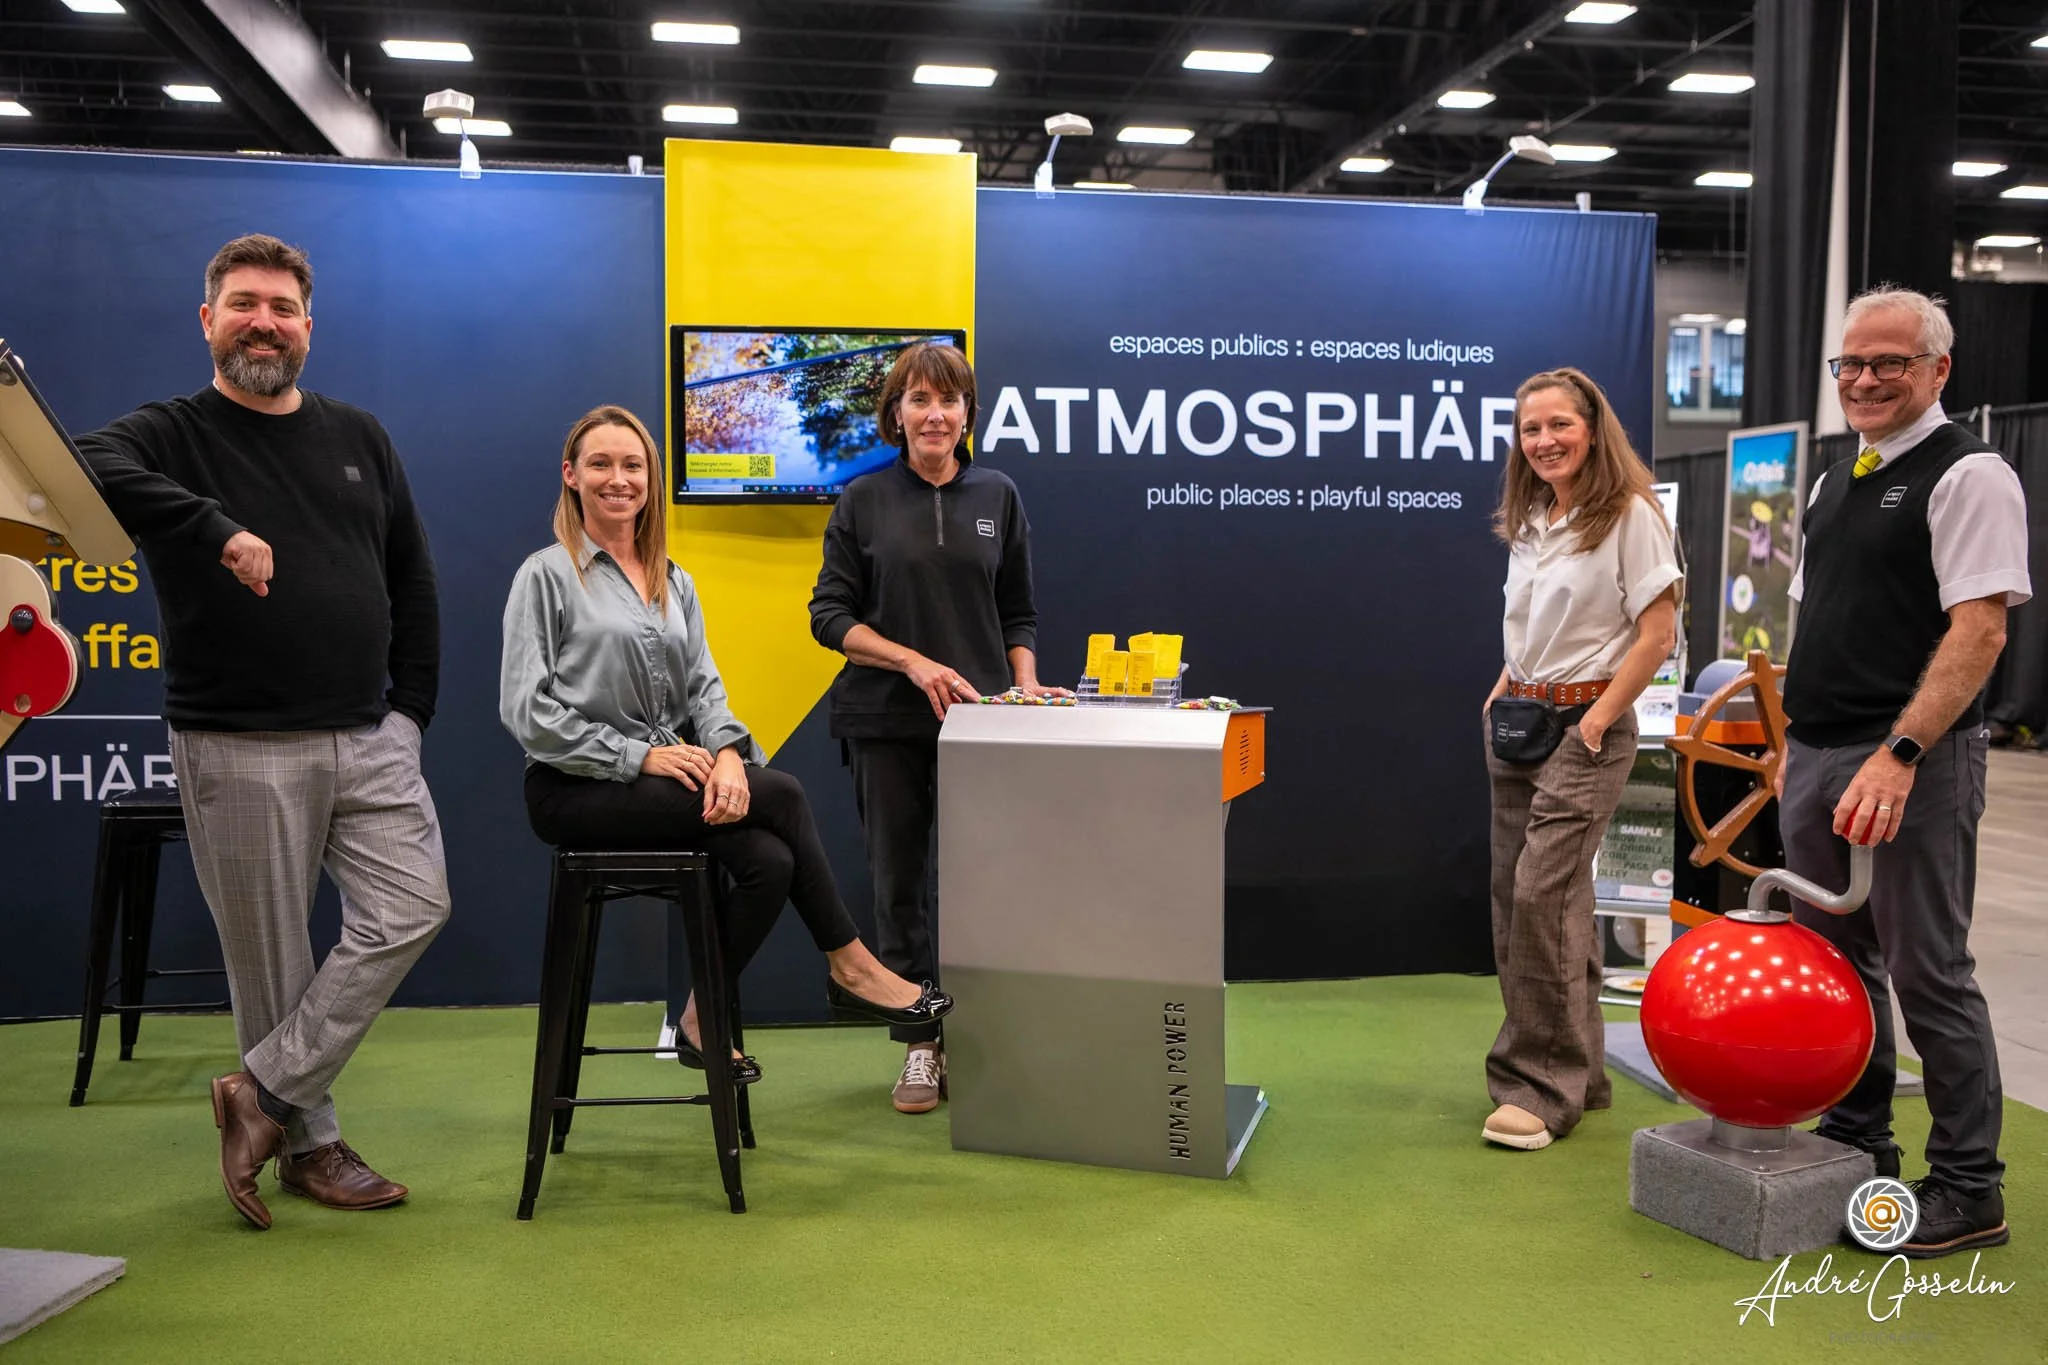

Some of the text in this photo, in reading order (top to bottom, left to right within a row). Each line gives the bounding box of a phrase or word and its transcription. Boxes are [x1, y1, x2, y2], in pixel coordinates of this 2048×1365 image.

[1109, 335, 1205, 359] espaces
[1210, 333, 1289, 361] publics
[1310, 340, 1401, 364] espaces
[1406, 338, 1495, 367] ludiques
[1147, 482, 1213, 510] public
[1220, 483, 1291, 511] places
[1310, 484, 1381, 512] playful
[1387, 490, 1462, 513] spaces
[36, 557, 139, 593] res
[0, 743, 178, 801] PHÄR
[1620, 824, 1664, 838] SAMPLE
[1164, 1000, 1192, 1161] HUMAN POWER
